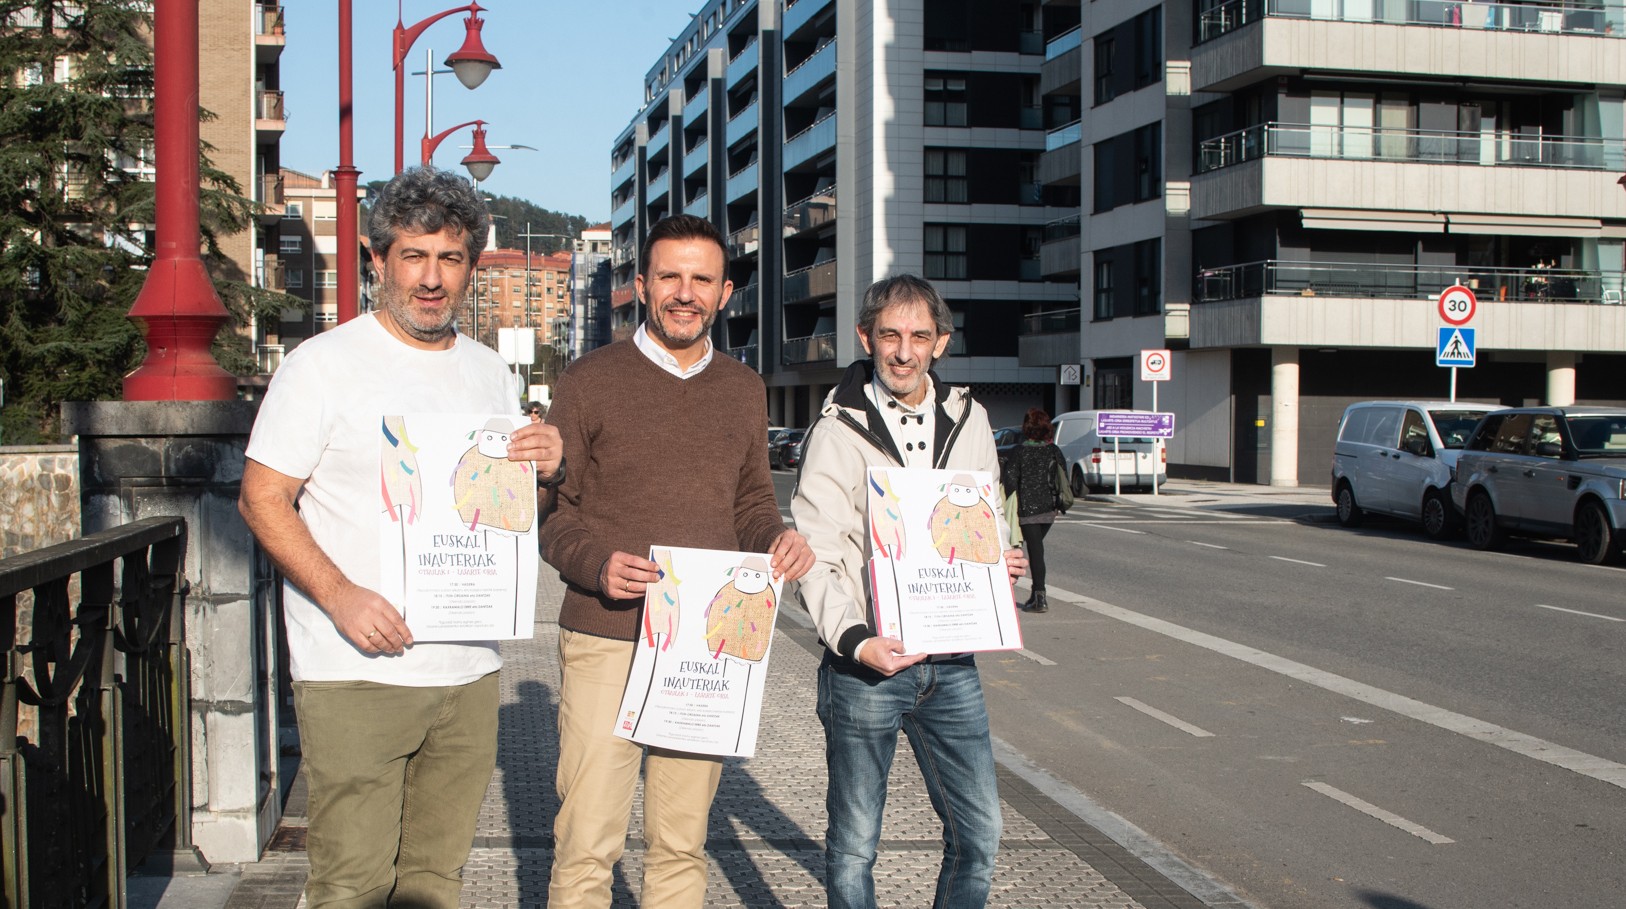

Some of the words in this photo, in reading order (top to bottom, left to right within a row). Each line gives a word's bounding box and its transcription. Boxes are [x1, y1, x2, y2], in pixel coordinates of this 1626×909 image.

[1448, 299, 1467, 312] 30
[433, 534, 480, 548] EUSKAL
[418, 553, 496, 568] INAUTERIAK
[918, 567, 958, 579] EUSKAL
[907, 582, 974, 594] INAUTERIAK
[679, 661, 720, 675] EUSKAL
[663, 676, 730, 692] INAUTERIAK
